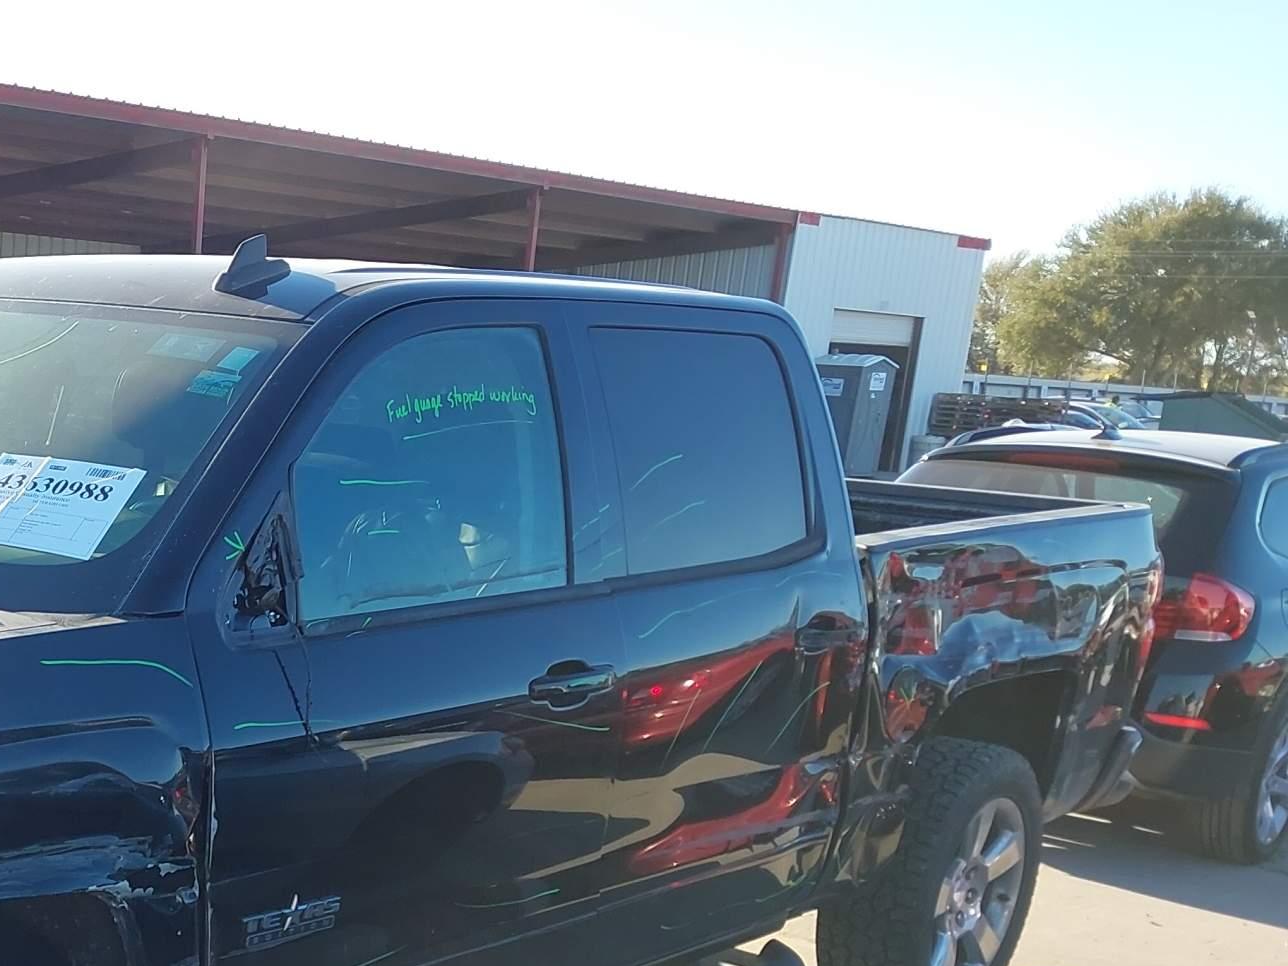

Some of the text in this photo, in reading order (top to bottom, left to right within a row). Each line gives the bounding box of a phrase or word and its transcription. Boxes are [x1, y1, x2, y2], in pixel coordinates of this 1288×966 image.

[386, 394, 412, 423] Fuel
[447, 383, 485, 411] stopped
[489, 385, 537, 416] working
[243, 894, 341, 934] TEXAS
